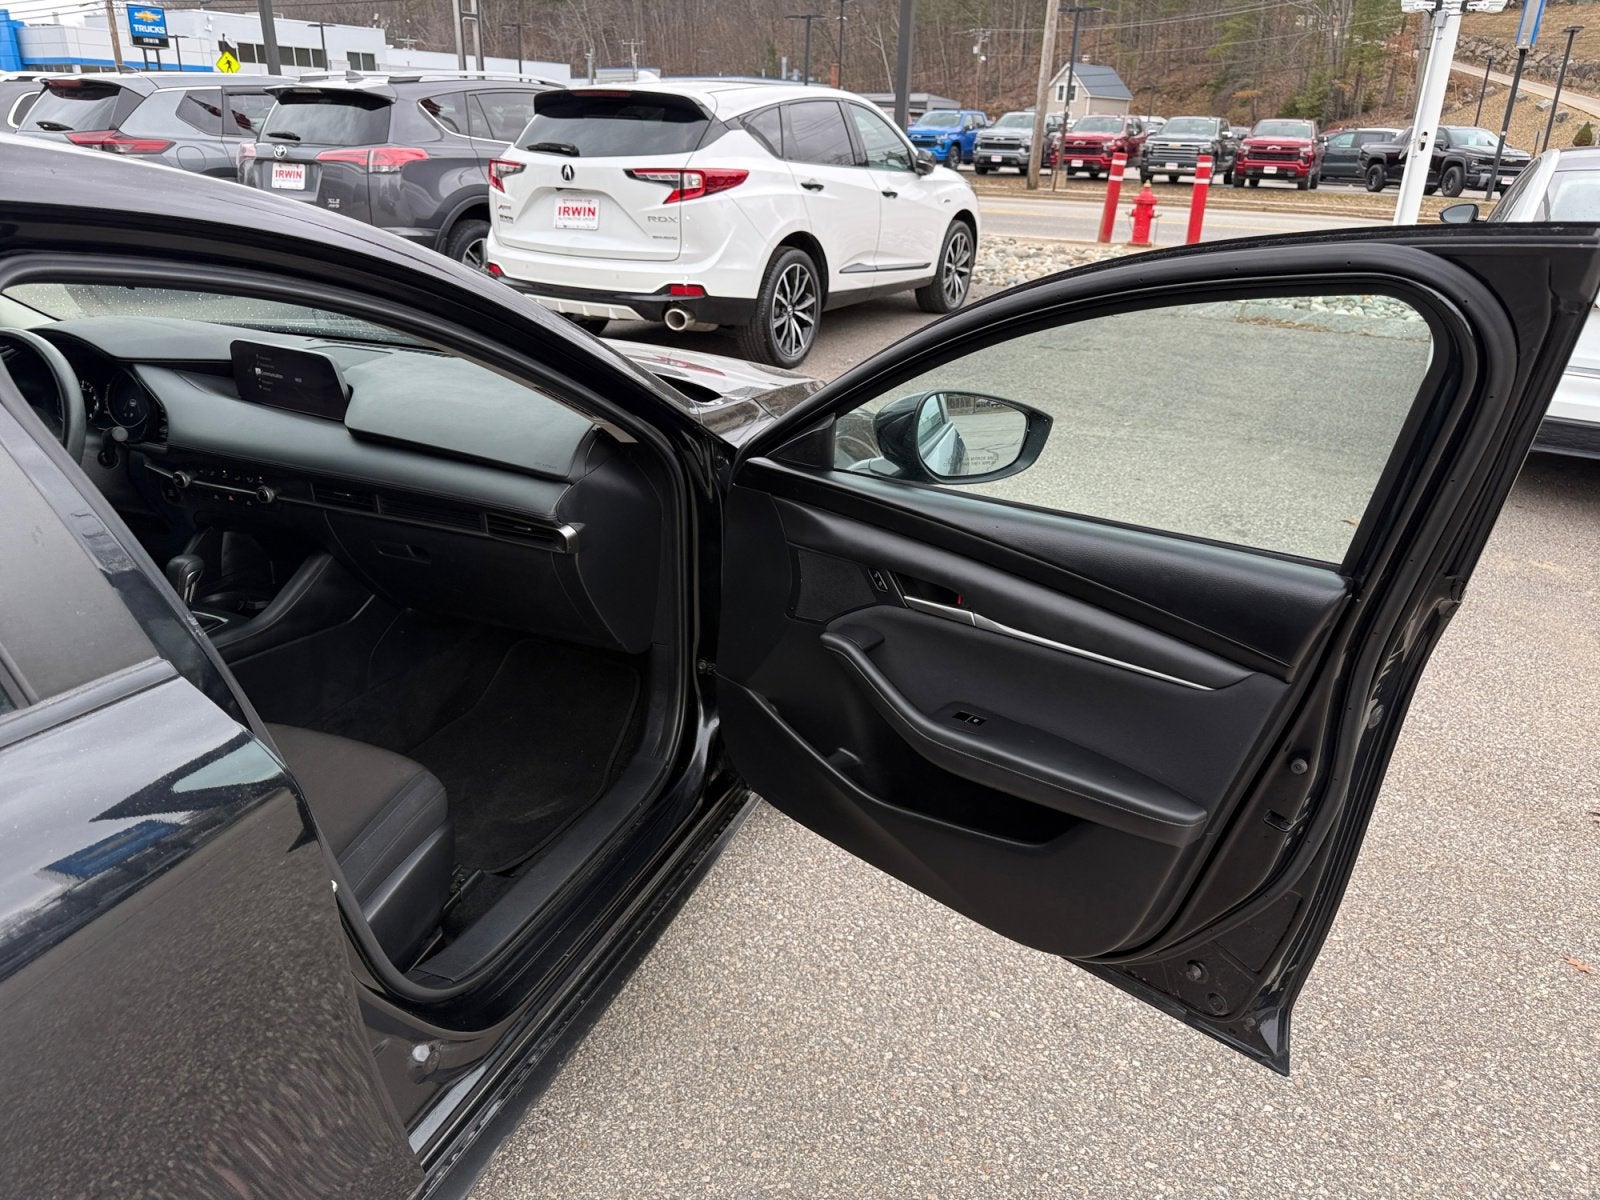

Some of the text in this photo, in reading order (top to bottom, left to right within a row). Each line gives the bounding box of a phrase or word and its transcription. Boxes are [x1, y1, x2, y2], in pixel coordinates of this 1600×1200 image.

[133, 24, 165, 33] TRUCKS
[275, 169, 302, 179] IRWIN
[558, 206, 596, 217] IRWIN
[647, 215, 679, 223] RDX
